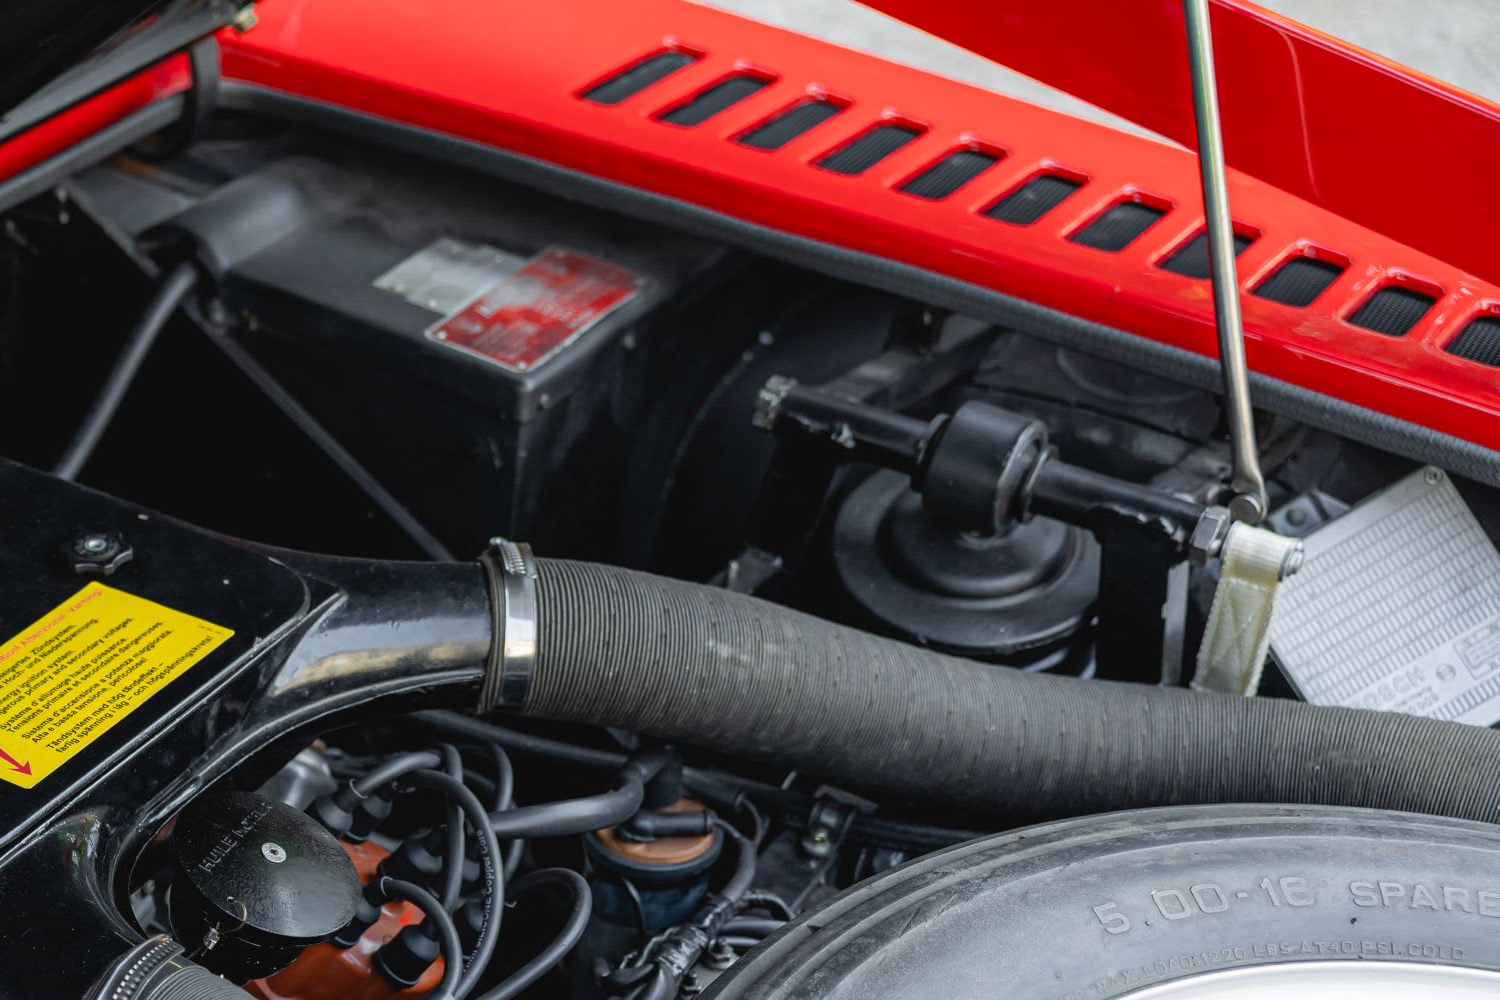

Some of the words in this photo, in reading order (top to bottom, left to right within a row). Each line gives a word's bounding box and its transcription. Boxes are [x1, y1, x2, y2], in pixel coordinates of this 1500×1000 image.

[18, 614, 66, 646] Attenzione!
[18, 668, 48, 688] ignition
[22, 674, 55, 696] primary
[51, 664, 68, 675] and
[65, 638, 105, 664] secondary
[24, 657, 41, 668] und
[68, 662, 92, 678] haute
[5, 708, 44, 732] Tensions
[40, 686, 74, 709] primaire
[79, 652, 120, 680] secondaire
[20, 716, 54, 739] Sistema
[104, 658, 134, 679] potenza
[30, 730, 50, 743] Alta
[51, 710, 78, 726] bassa
[107, 656, 148, 686] pericolose!
[44, 715, 94, 749] Tändsystem
[90, 703, 110, 716] med
[106, 692, 126, 704] hög
[120, 666, 158, 692] tändeffekt
[54, 736, 80, 753] farlig
[75, 712, 114, 738] spänning
[131, 684, 148, 696] och
[1092, 876, 1315, 935] 5.00-16
[1350, 879, 1500, 918] SPARE
[1407, 943, 1466, 960] COLD
